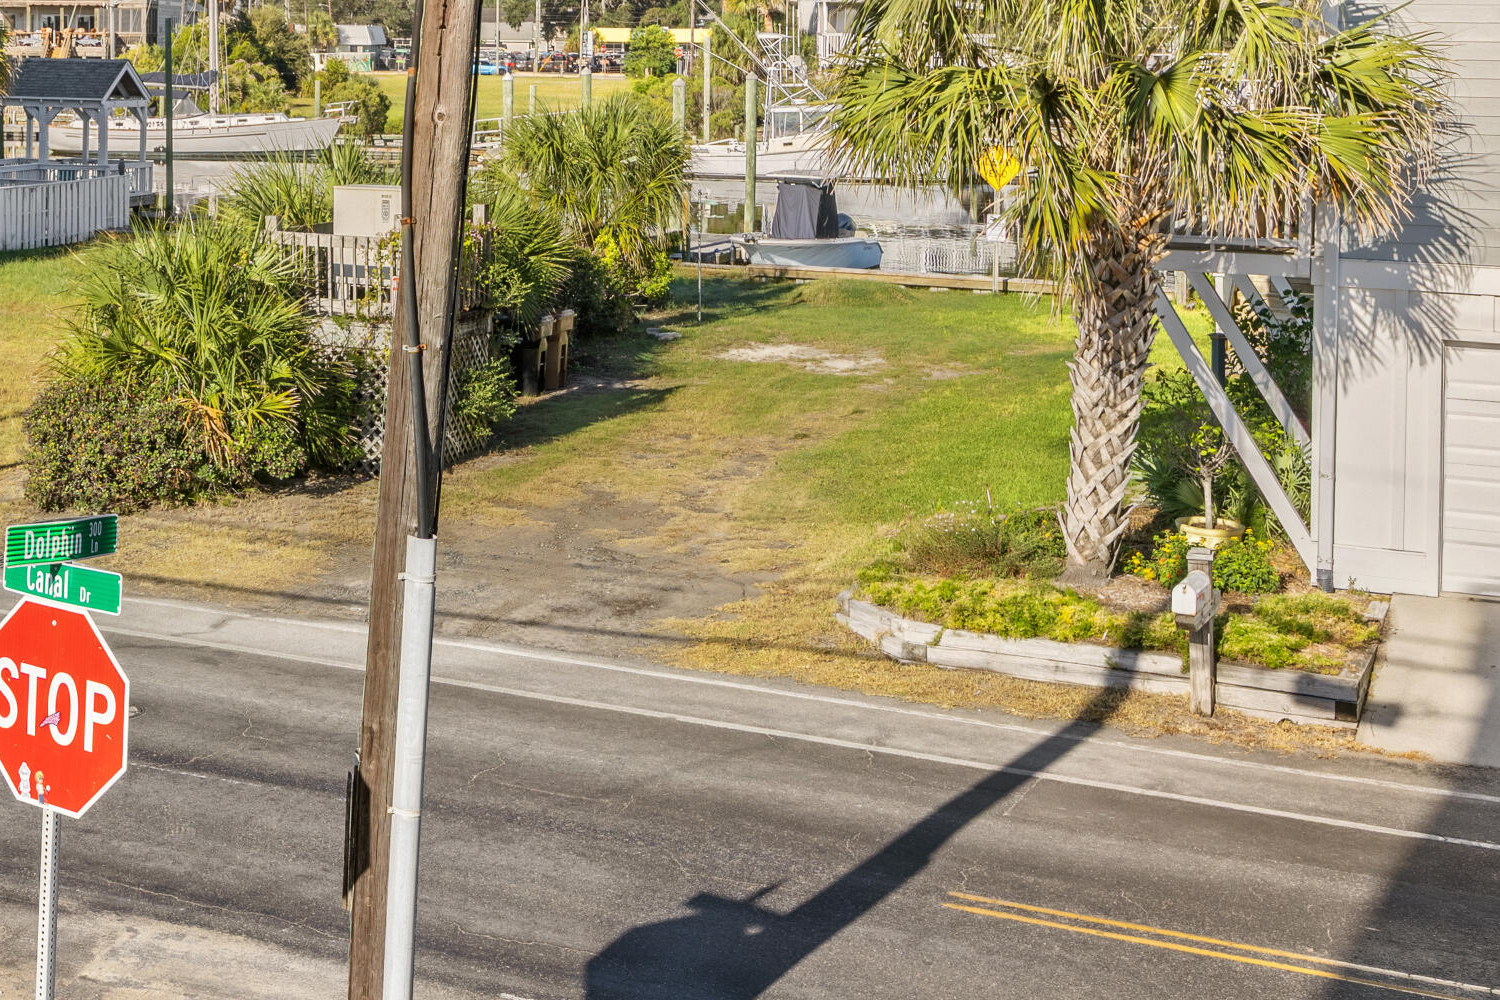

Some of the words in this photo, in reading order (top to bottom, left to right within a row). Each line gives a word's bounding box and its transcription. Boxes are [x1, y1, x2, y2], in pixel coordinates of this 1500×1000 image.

[24, 526, 82, 559] Dolphin
[90, 540, 99, 553] Ln
[89, 520, 102, 537] 300
[26, 565, 69, 599] Canal
[80, 586, 91, 603] Dr
